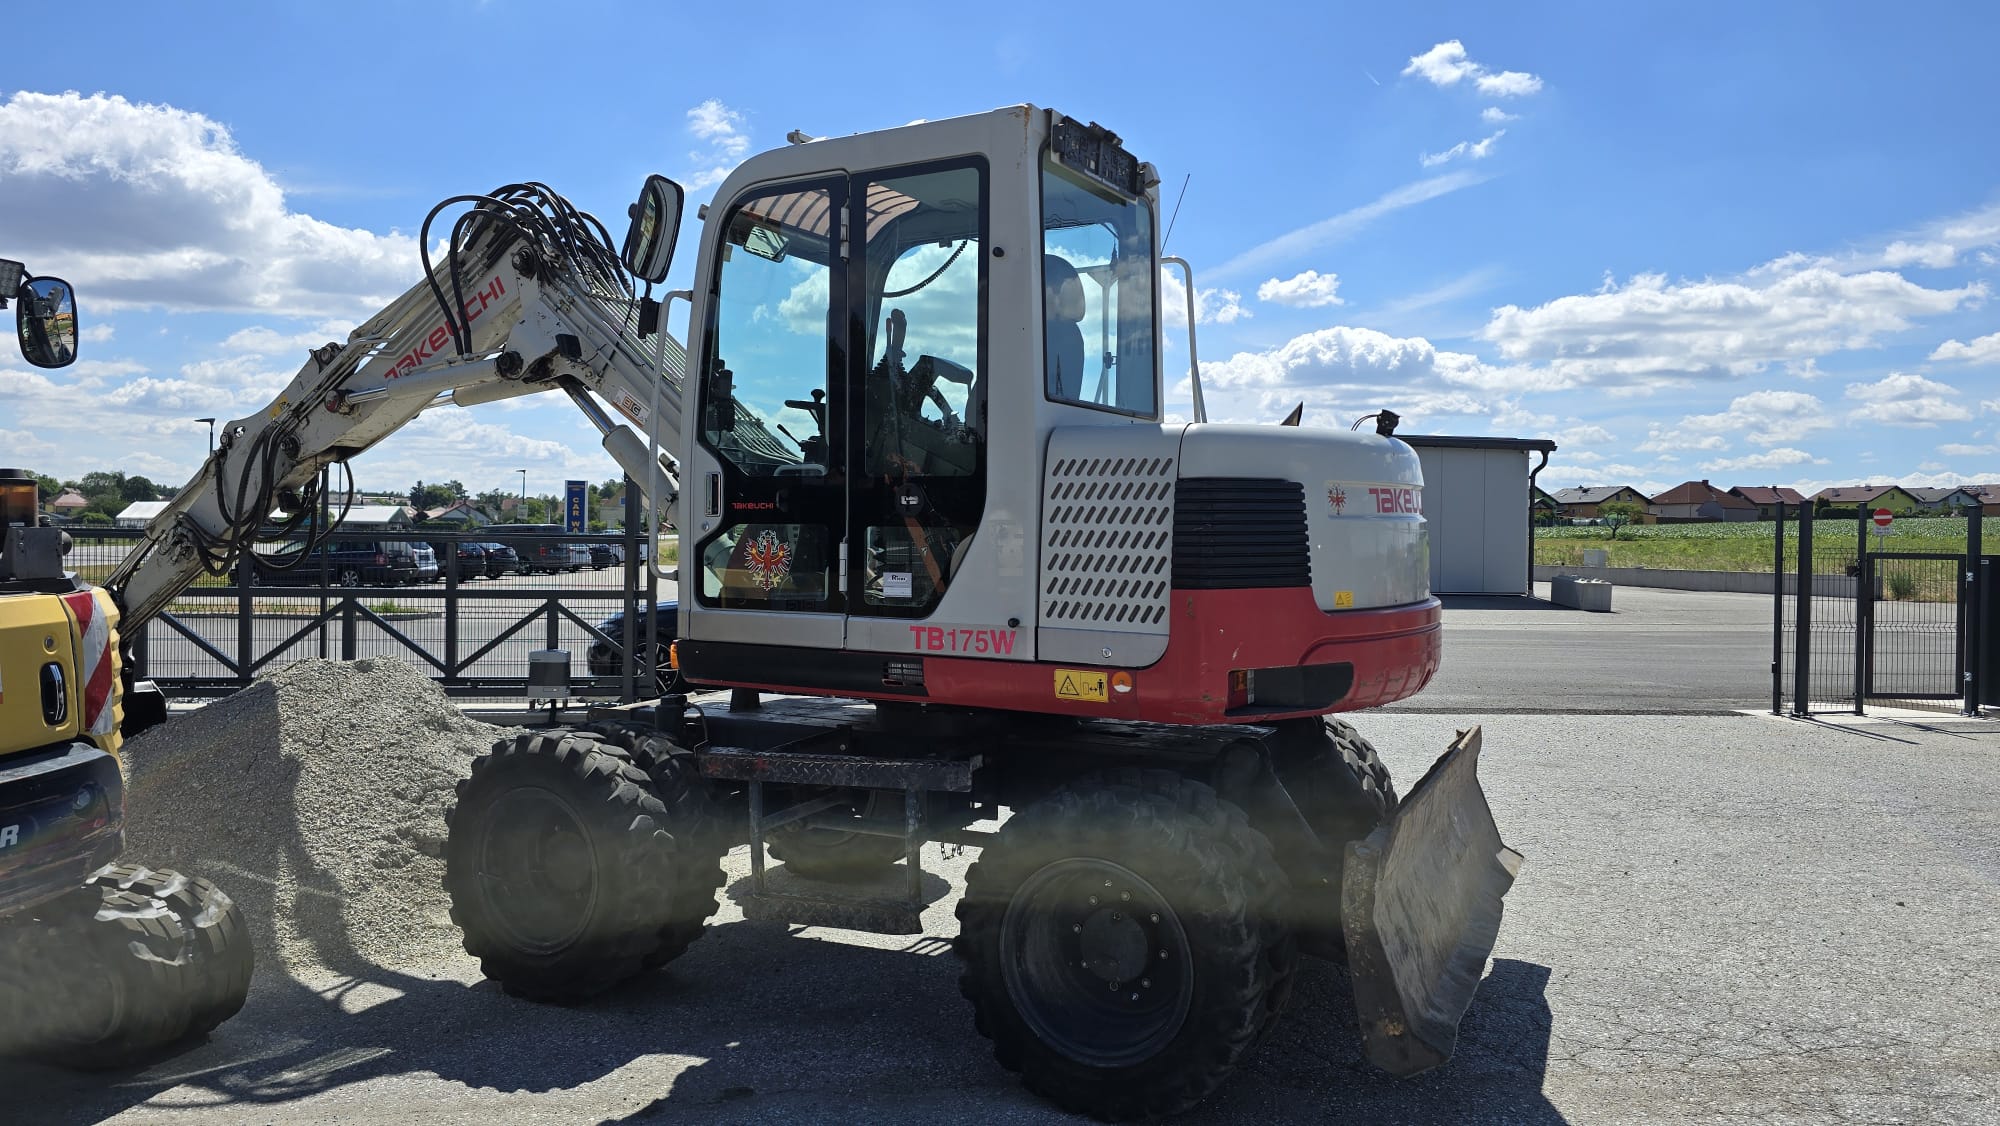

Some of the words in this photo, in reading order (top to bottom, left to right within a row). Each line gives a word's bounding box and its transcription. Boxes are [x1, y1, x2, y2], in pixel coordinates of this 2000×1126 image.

[572, 497, 580, 517] CAR
[731, 502, 774, 510] TAKEUCHI
[909, 625, 1017, 655] TB175W
